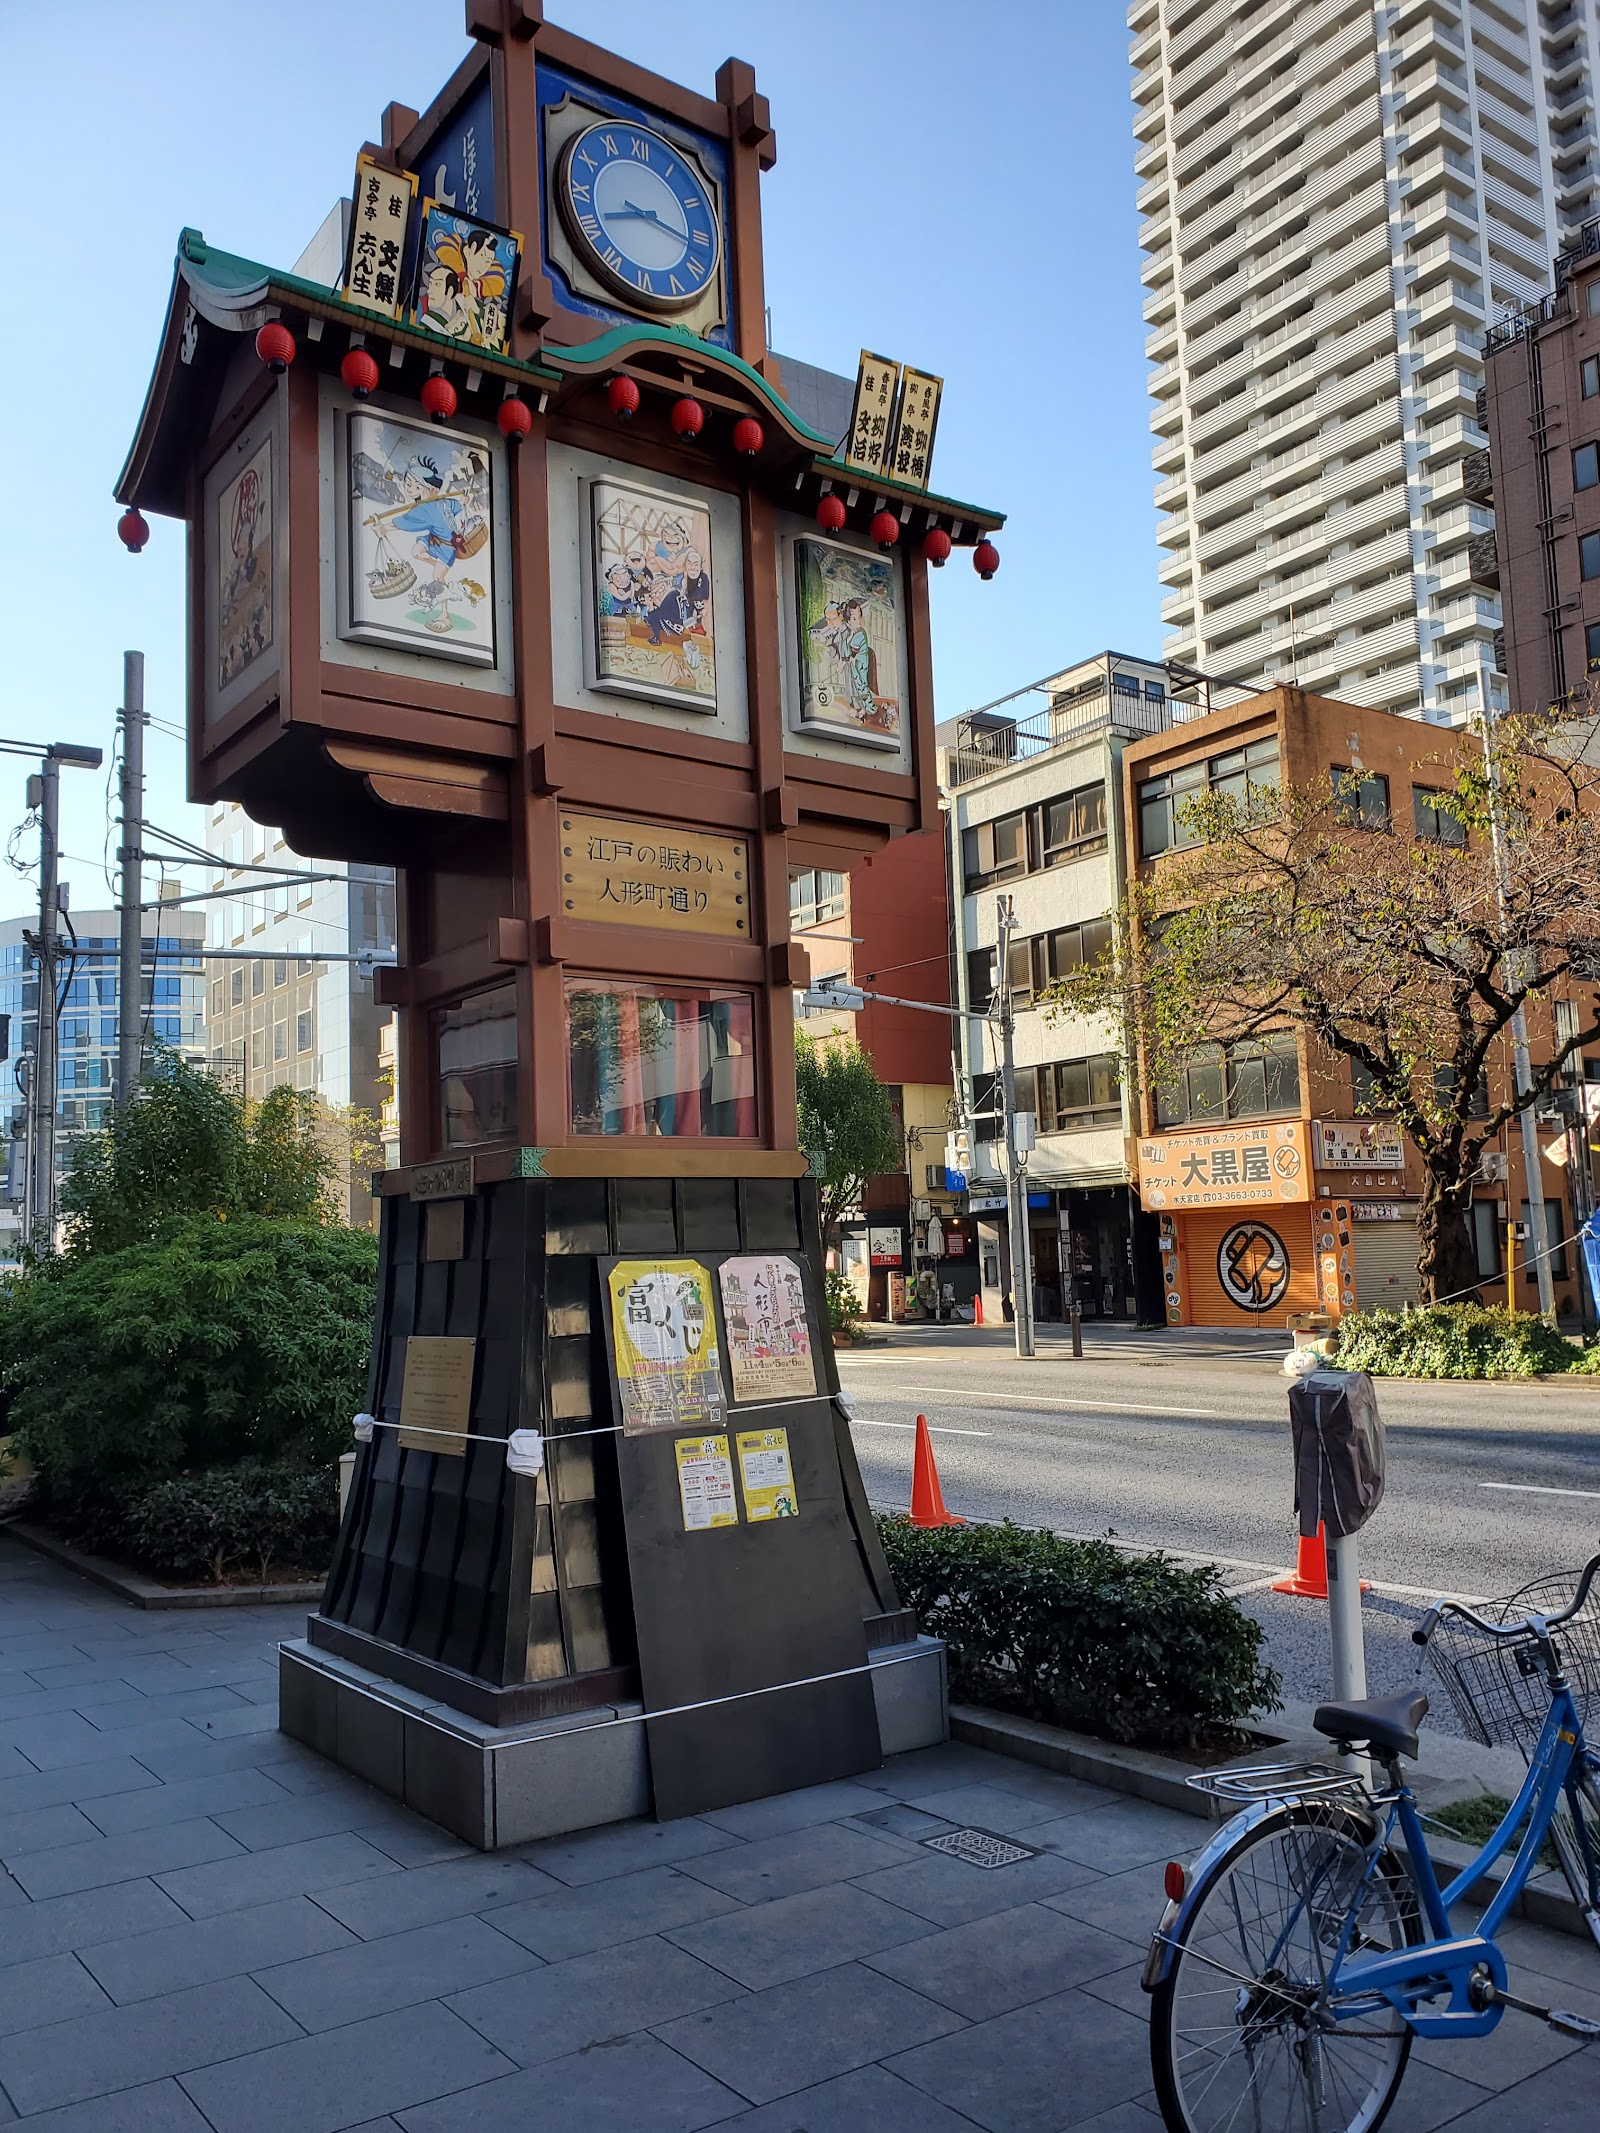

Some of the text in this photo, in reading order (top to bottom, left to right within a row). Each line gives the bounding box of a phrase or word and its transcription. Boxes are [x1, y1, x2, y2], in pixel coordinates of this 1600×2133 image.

[364, 176, 381, 222] 古今亭
[388, 194, 403, 219] 桂
[865, 373, 875, 392] 桂
[587, 835, 724, 874] 江戸の賑わい
[599, 877, 708, 914] 人形町通り
[1180, 1145, 1271, 1188] 大黒屋
[1144, 1176, 1177, 1189] チケット
[1351, 1174, 1399, 1186] 大島ビル
[1173, 1193, 1200, 1204] 水天宮店
[753, 1273, 773, 1335] 人形市
[702, 1440, 726, 1454] 富くじ
